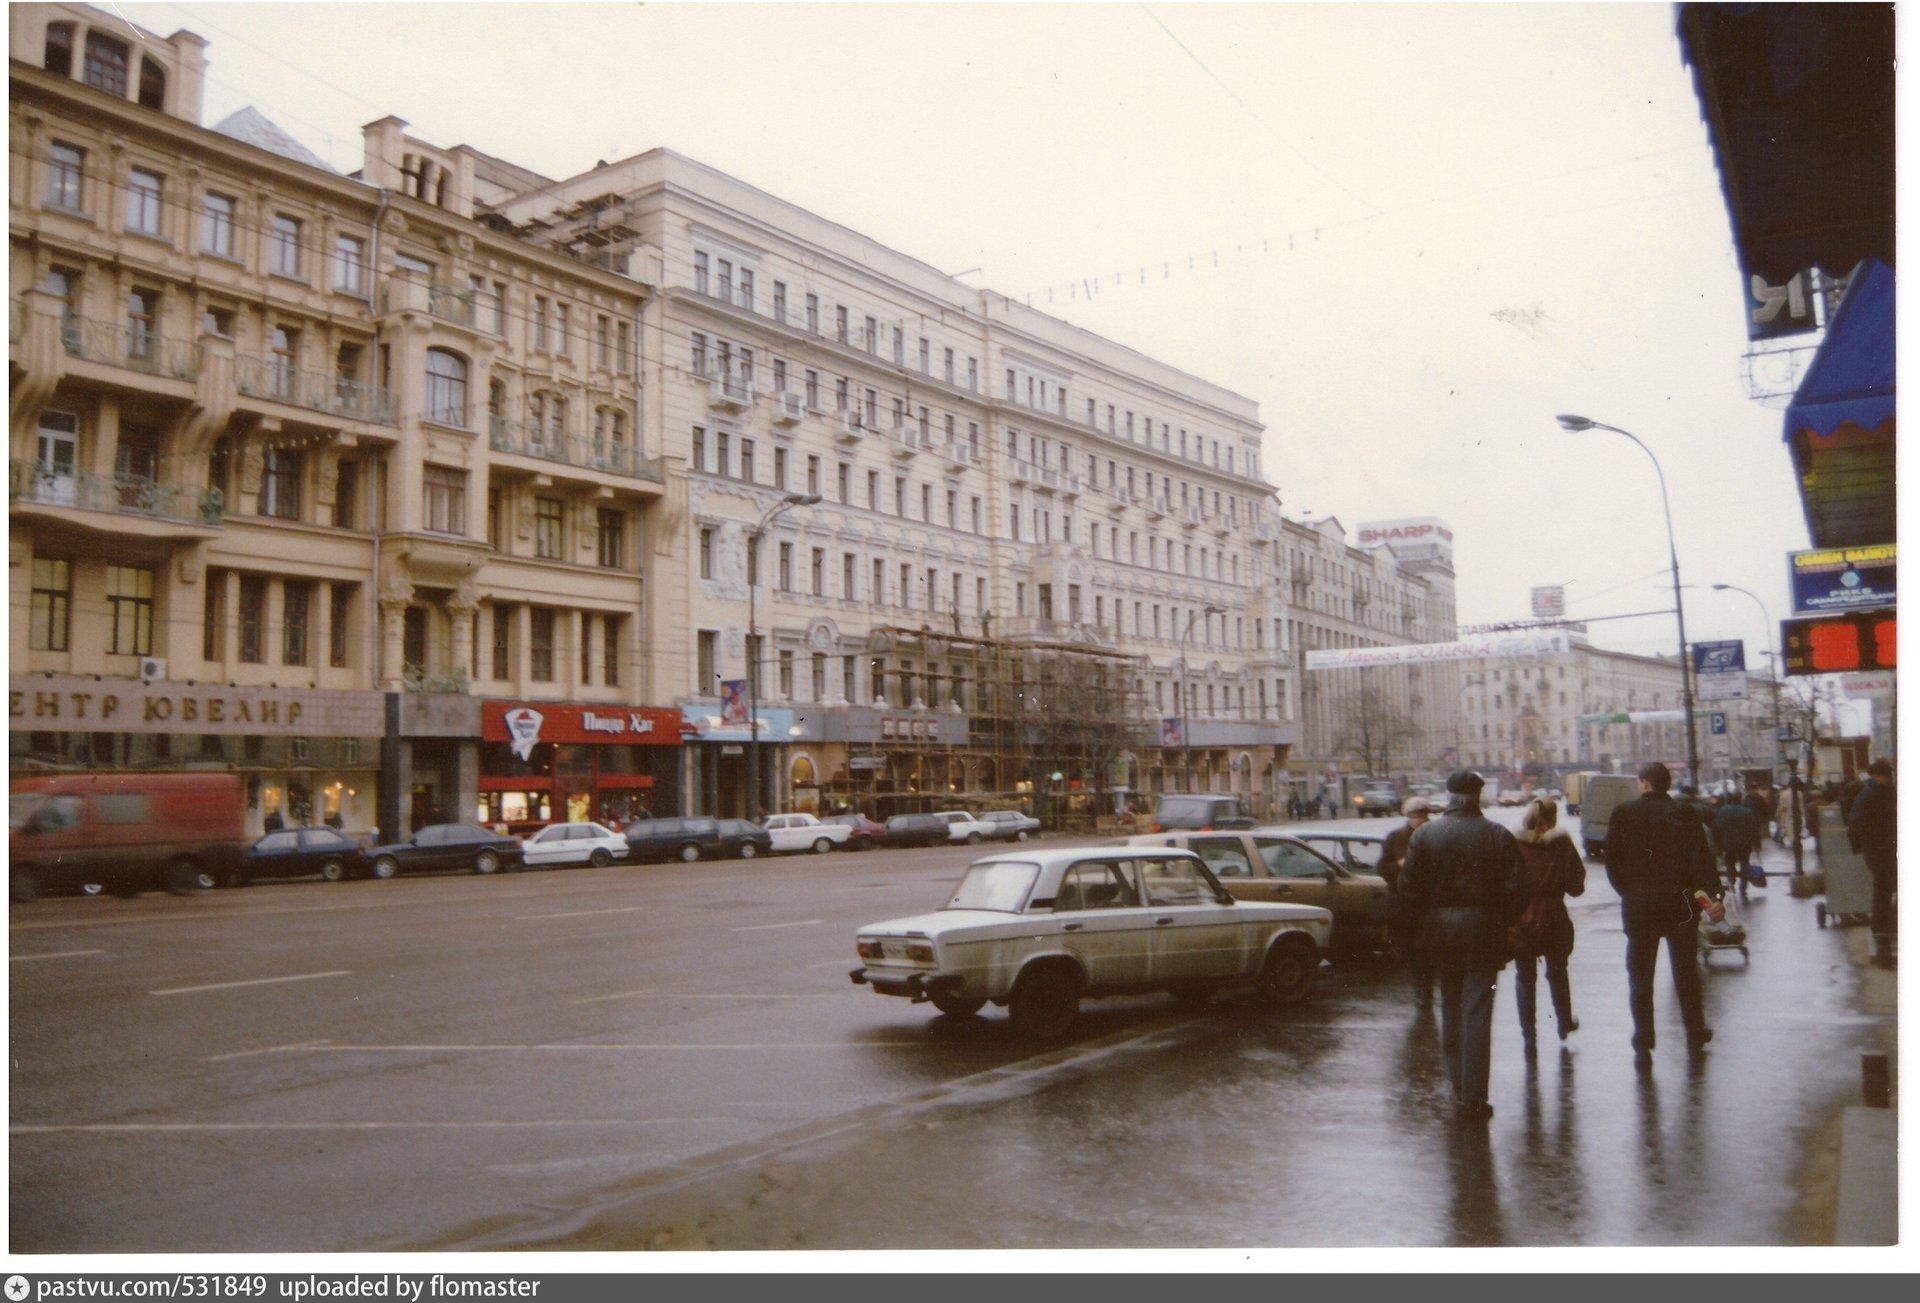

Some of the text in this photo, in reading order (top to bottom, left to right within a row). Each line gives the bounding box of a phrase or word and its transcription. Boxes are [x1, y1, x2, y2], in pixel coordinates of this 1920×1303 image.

[1358, 524, 1433, 542] SHARP
[143, 696, 304, 724] ЮВЕЛИР
[1714, 715, 1724, 733] P
